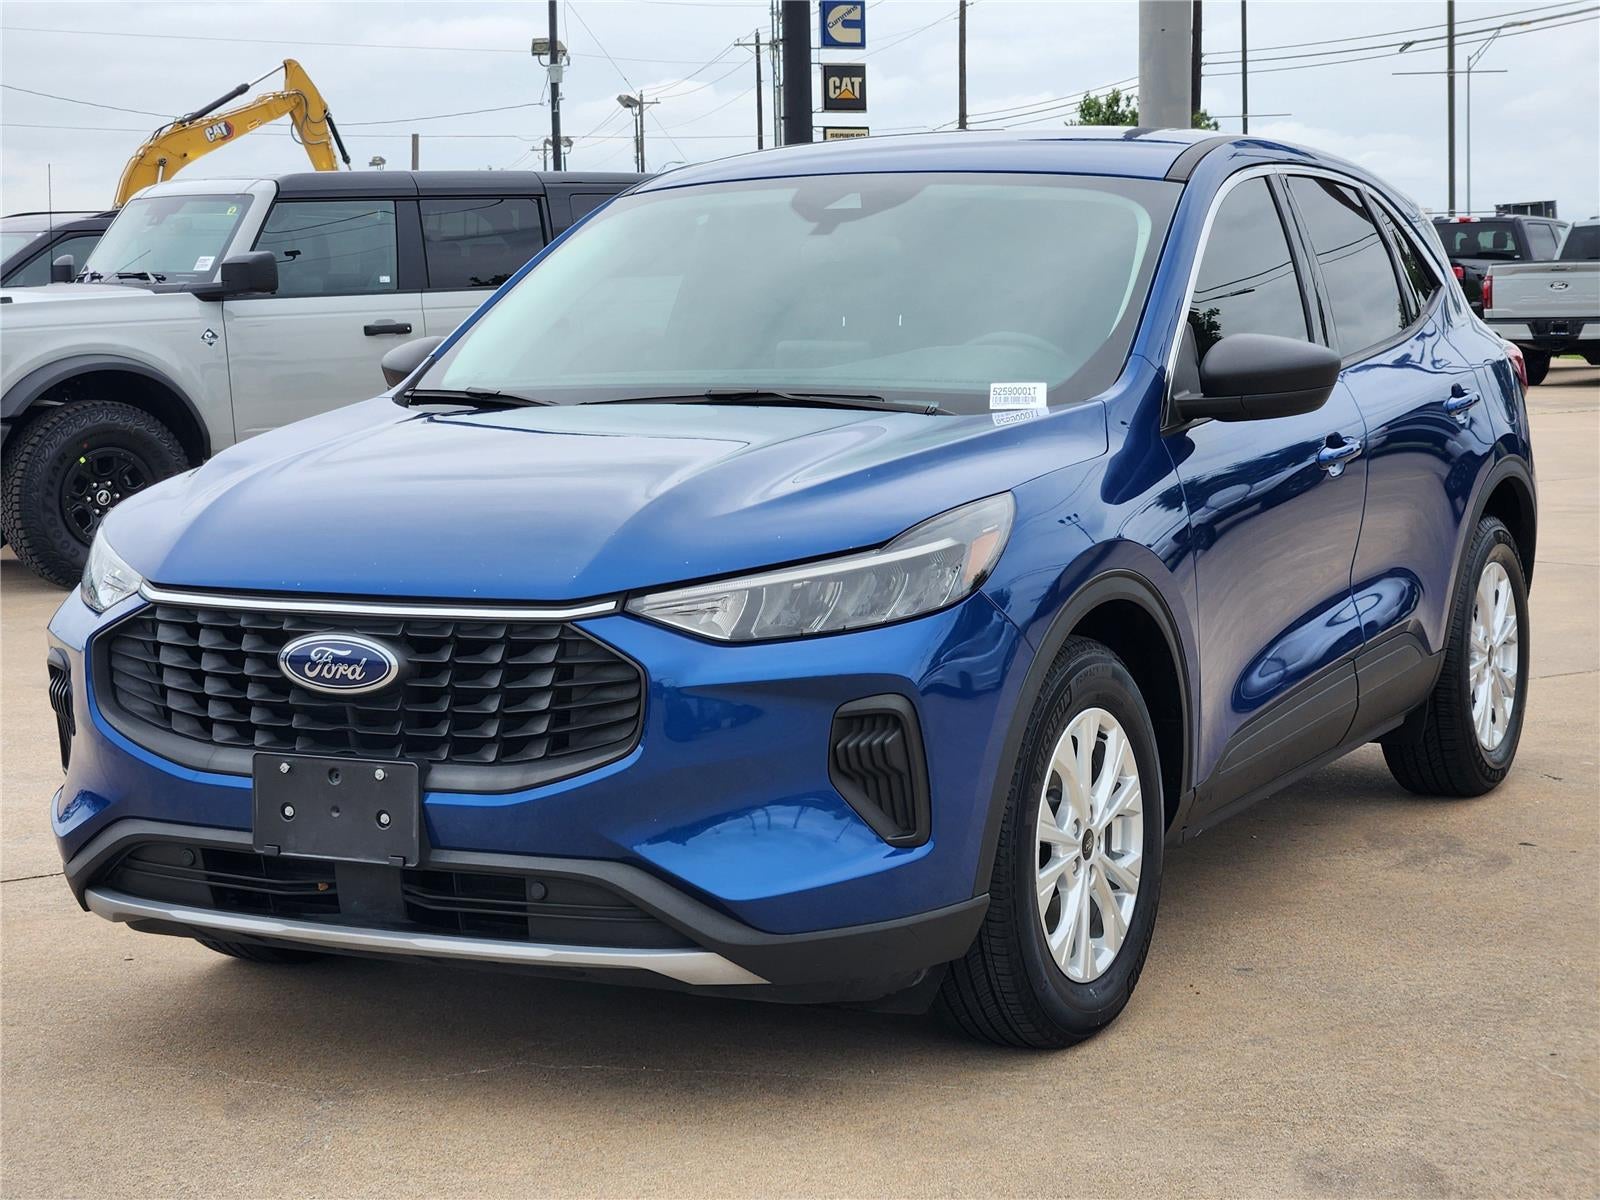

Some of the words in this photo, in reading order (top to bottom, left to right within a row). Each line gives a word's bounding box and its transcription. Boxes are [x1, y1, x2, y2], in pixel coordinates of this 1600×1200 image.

[828, 5, 858, 28] Cummins
[829, 76, 862, 99] CAT
[205, 122, 228, 142] CAT
[992, 387, 1037, 396] 52590001T
[304, 646, 368, 680] Ford
[1034, 690, 1072, 776] MICHELIN
